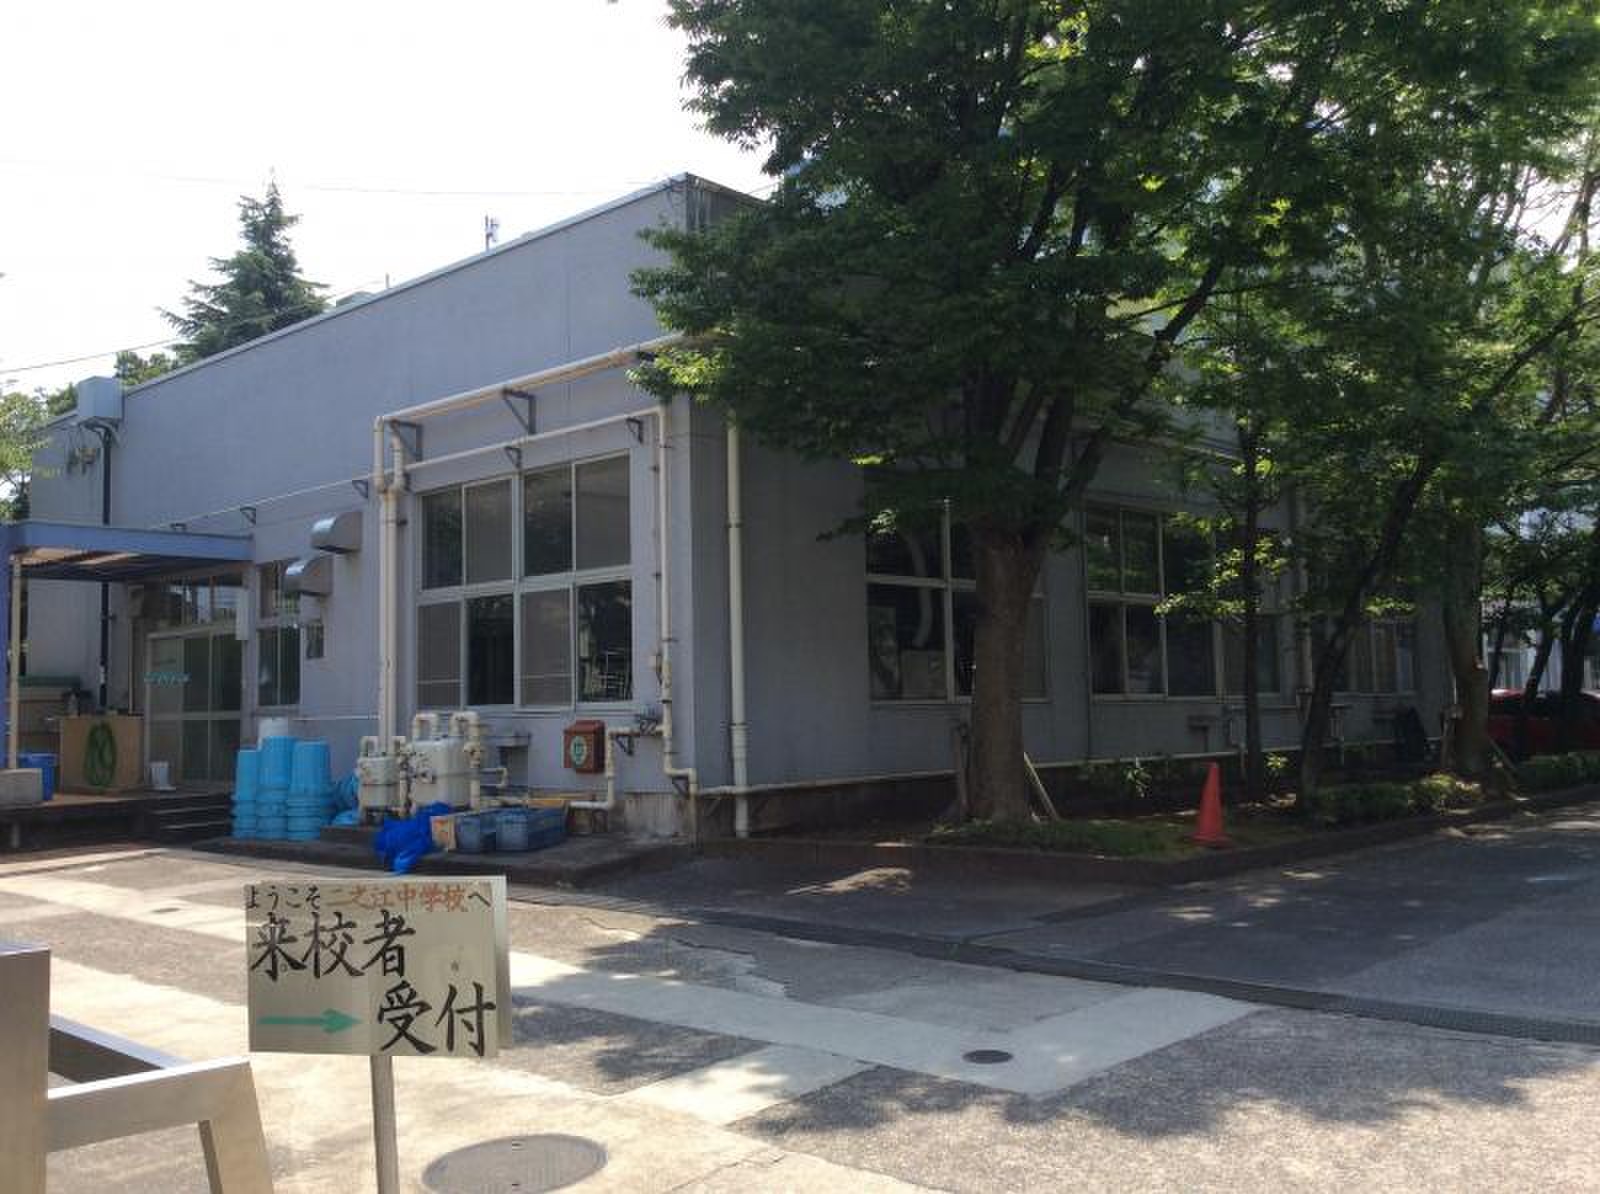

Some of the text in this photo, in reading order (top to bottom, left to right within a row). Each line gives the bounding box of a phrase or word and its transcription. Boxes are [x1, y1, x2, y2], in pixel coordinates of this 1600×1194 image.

[251, 910, 416, 980] 来校者
[377, 980, 497, 1056] 受付
